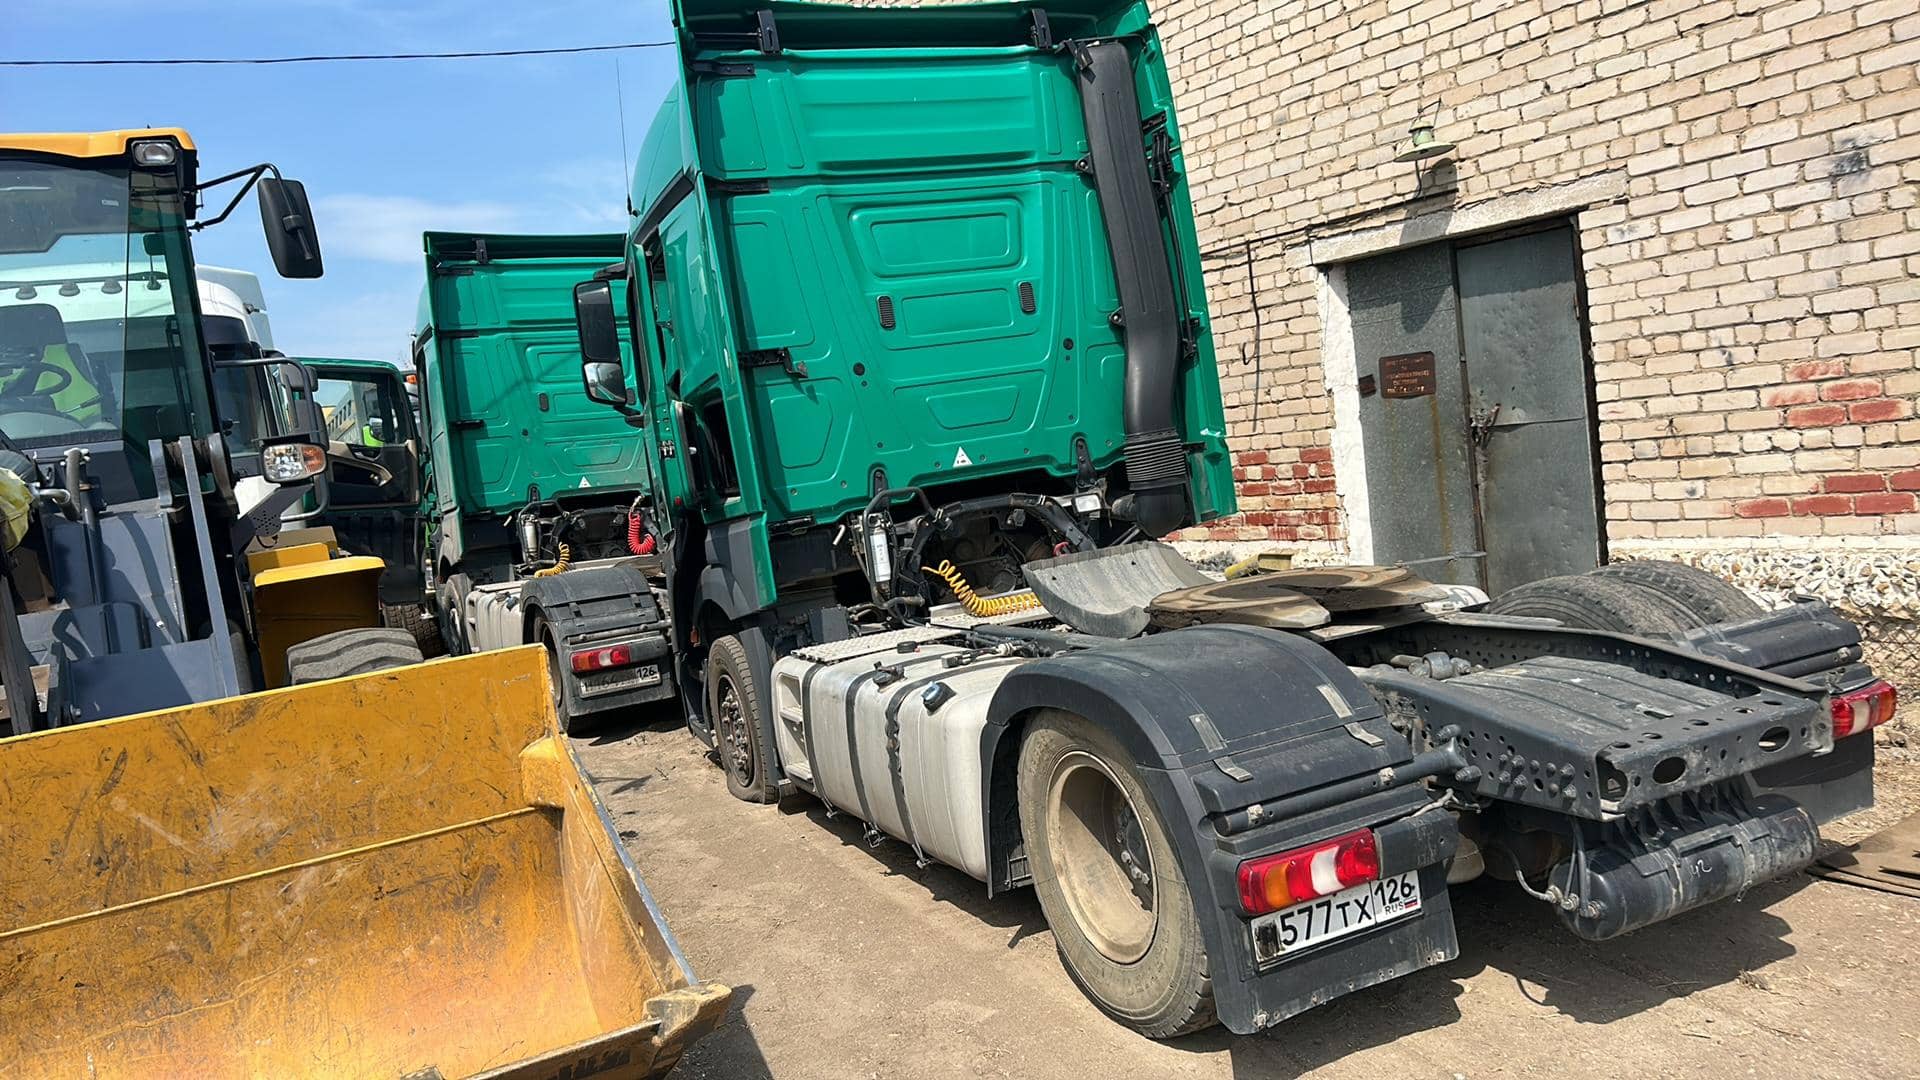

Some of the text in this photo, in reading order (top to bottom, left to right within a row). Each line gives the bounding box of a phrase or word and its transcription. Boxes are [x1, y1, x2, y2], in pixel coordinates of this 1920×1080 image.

[636, 667, 655, 678] 126
[1256, 873, 1412, 956] 577TX 126
[1384, 900, 1404, 915] RUS
